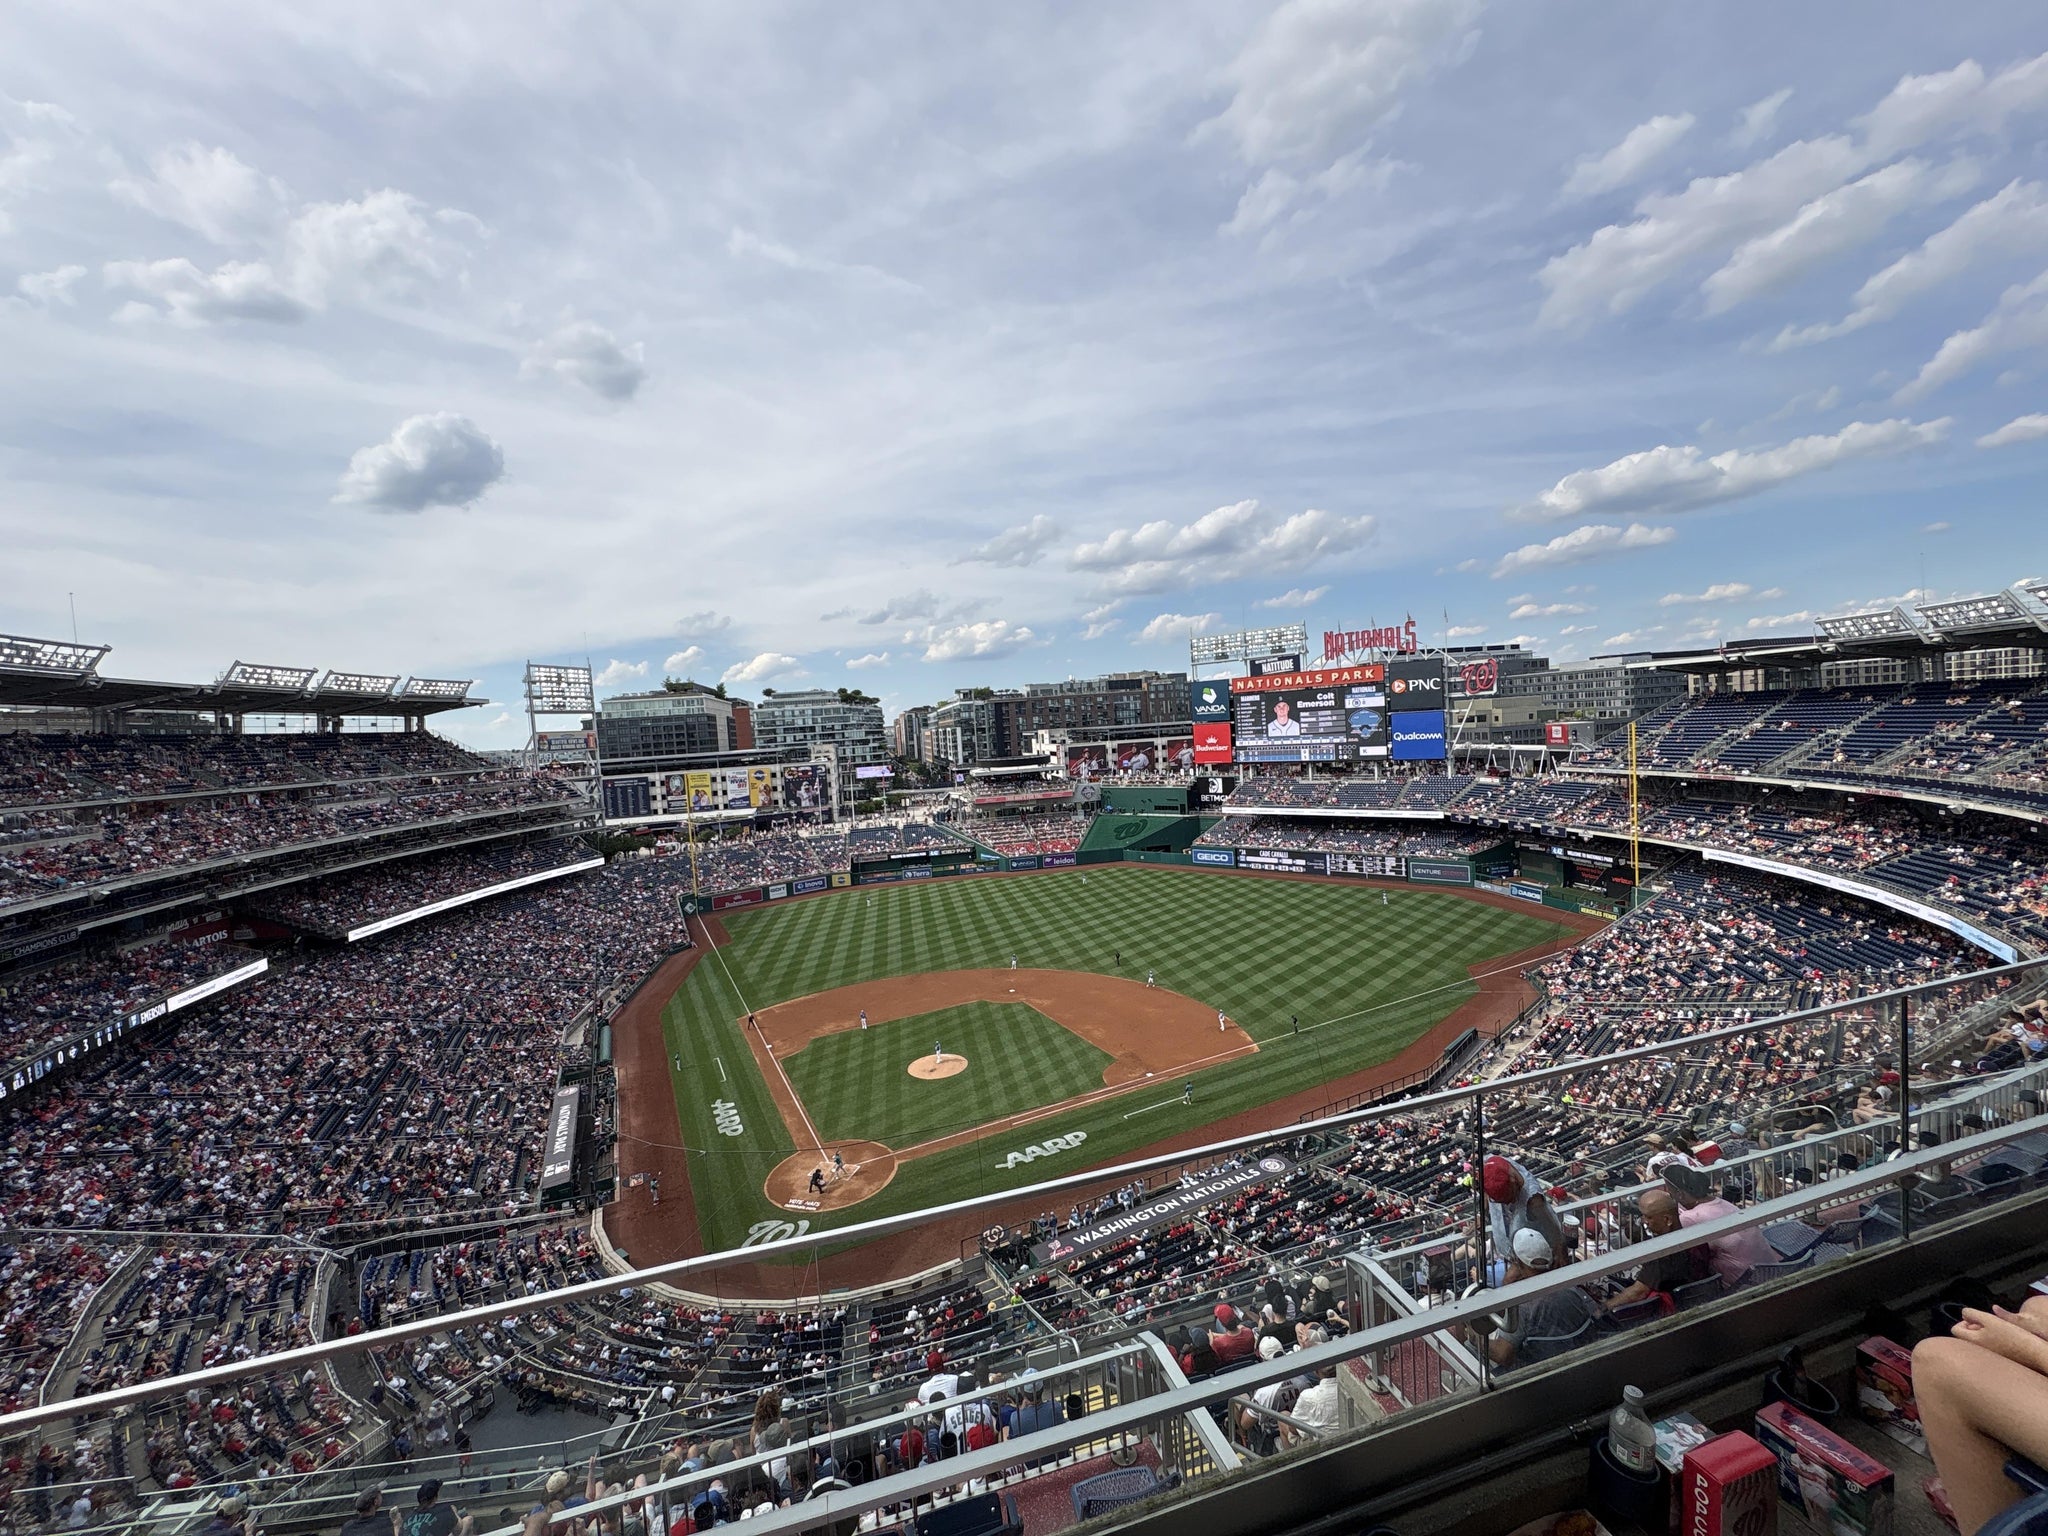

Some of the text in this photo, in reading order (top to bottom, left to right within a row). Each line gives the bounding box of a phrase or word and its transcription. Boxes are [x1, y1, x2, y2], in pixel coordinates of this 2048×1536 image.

[1323, 620, 1417, 660] NATIONALS
[1261, 659, 1294, 673] NATITUDE
[1236, 669, 1375, 690] NATIONALS PARK
[1408, 677, 1441, 691] PNC
[1316, 692, 1335, 700] Colt
[1194, 704, 1227, 713] VANDA
[1296, 700, 1335, 708] Emerson
[1393, 731, 1443, 742] Qualcomm
[1195, 744, 1229, 752] Budweiser
[1053, 857, 1075, 865] leidos
[1197, 853, 1229, 862] GEICO
[912, 870, 930, 878] Terra
[1413, 868, 1442, 876] VENTURE
[804, 879, 824, 888] Inova
[13, 936, 58, 957] CHAMPIONS
[58, 931, 77, 944] CLUB
[191, 929, 229, 948] ARTOIS
[140, 1002, 167, 1025] EMERSON
[83, 1038, 89, 1052] 3
[57, 1050, 65, 1065] 0
[553, 1136, 568, 1155] PARK
[994, 1131, 1088, 1170] AARP
[1072, 1167, 1262, 1246] WASHINGTON NATIONALS
